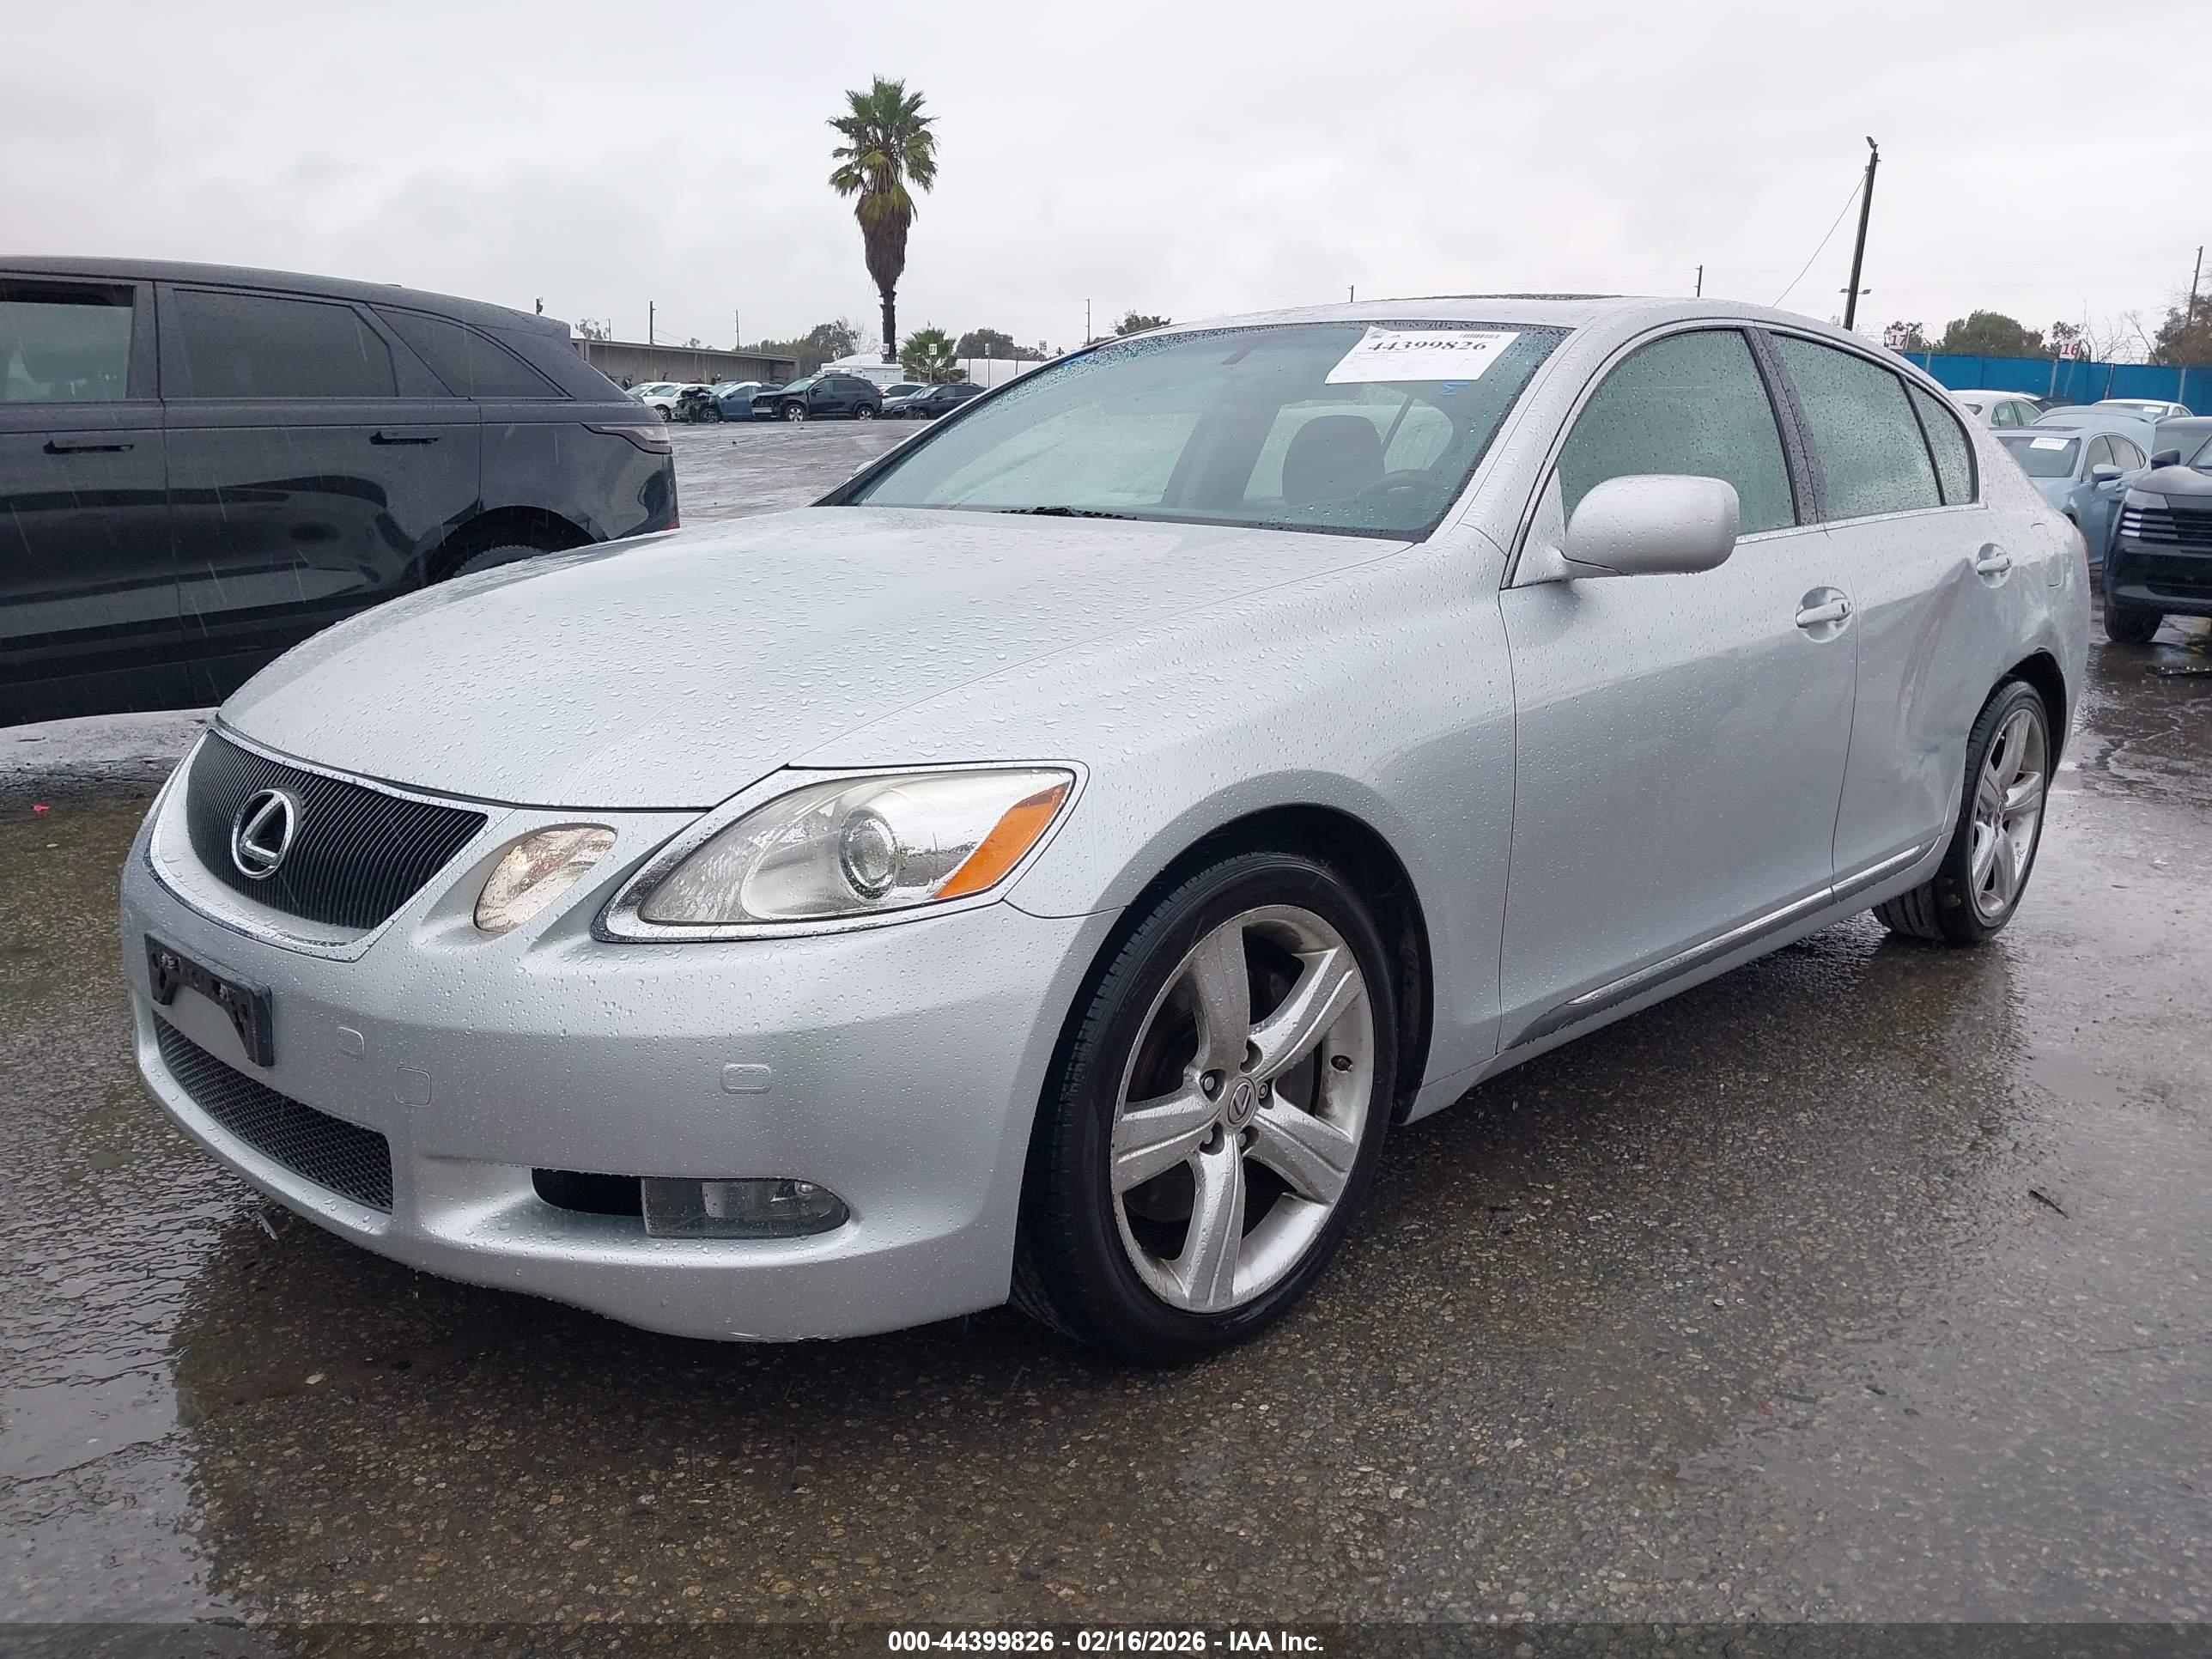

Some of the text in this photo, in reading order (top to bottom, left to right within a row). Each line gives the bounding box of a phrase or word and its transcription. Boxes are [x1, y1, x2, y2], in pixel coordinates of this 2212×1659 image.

[1890, 334, 1906, 347] 17
[929, 345, 937, 354] 27
[1039, 343, 1048, 351] 25
[1367, 341, 1490, 351] 44399826
[2062, 343, 2079, 356] 16
